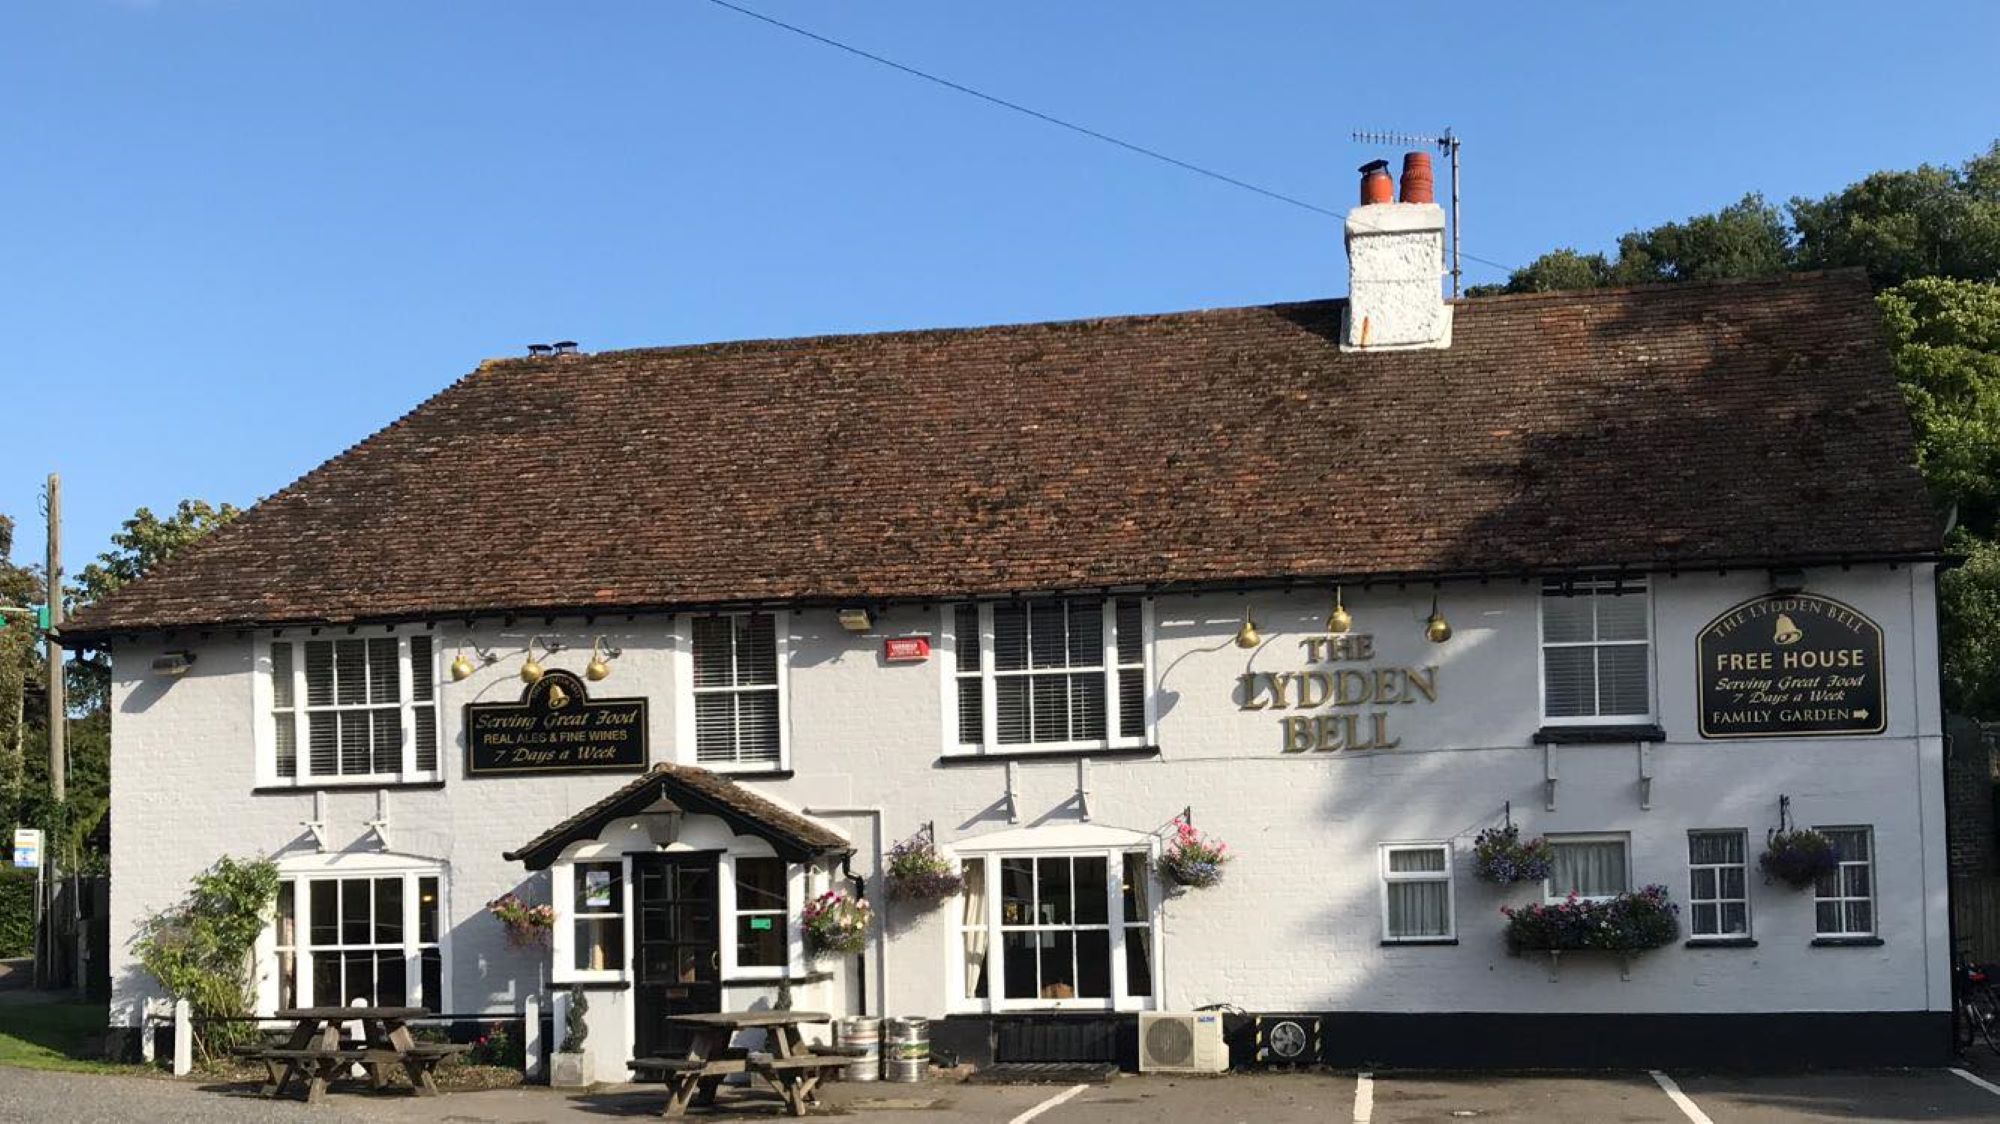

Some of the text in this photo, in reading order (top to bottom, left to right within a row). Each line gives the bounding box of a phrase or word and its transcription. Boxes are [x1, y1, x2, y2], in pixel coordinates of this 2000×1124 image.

[1712, 600, 1865, 638] THE LYDDEN BELL
[1299, 634, 1376, 664] THE
[1717, 650, 1865, 671] FREE HOUSE
[1236, 665, 1440, 711] LYDDEN
[1715, 674, 1866, 692] Serving Great Food
[1732, 689, 1846, 705] 7 Days a Week
[476, 708, 639, 730] Serving Great Food
[1712, 708, 1850, 725] FAMILY GARDEN
[483, 729, 628, 745] REAL ALES & FINE WINES
[1278, 711, 1402, 754] BELL
[494, 745, 618, 765] 7 Days a Week
